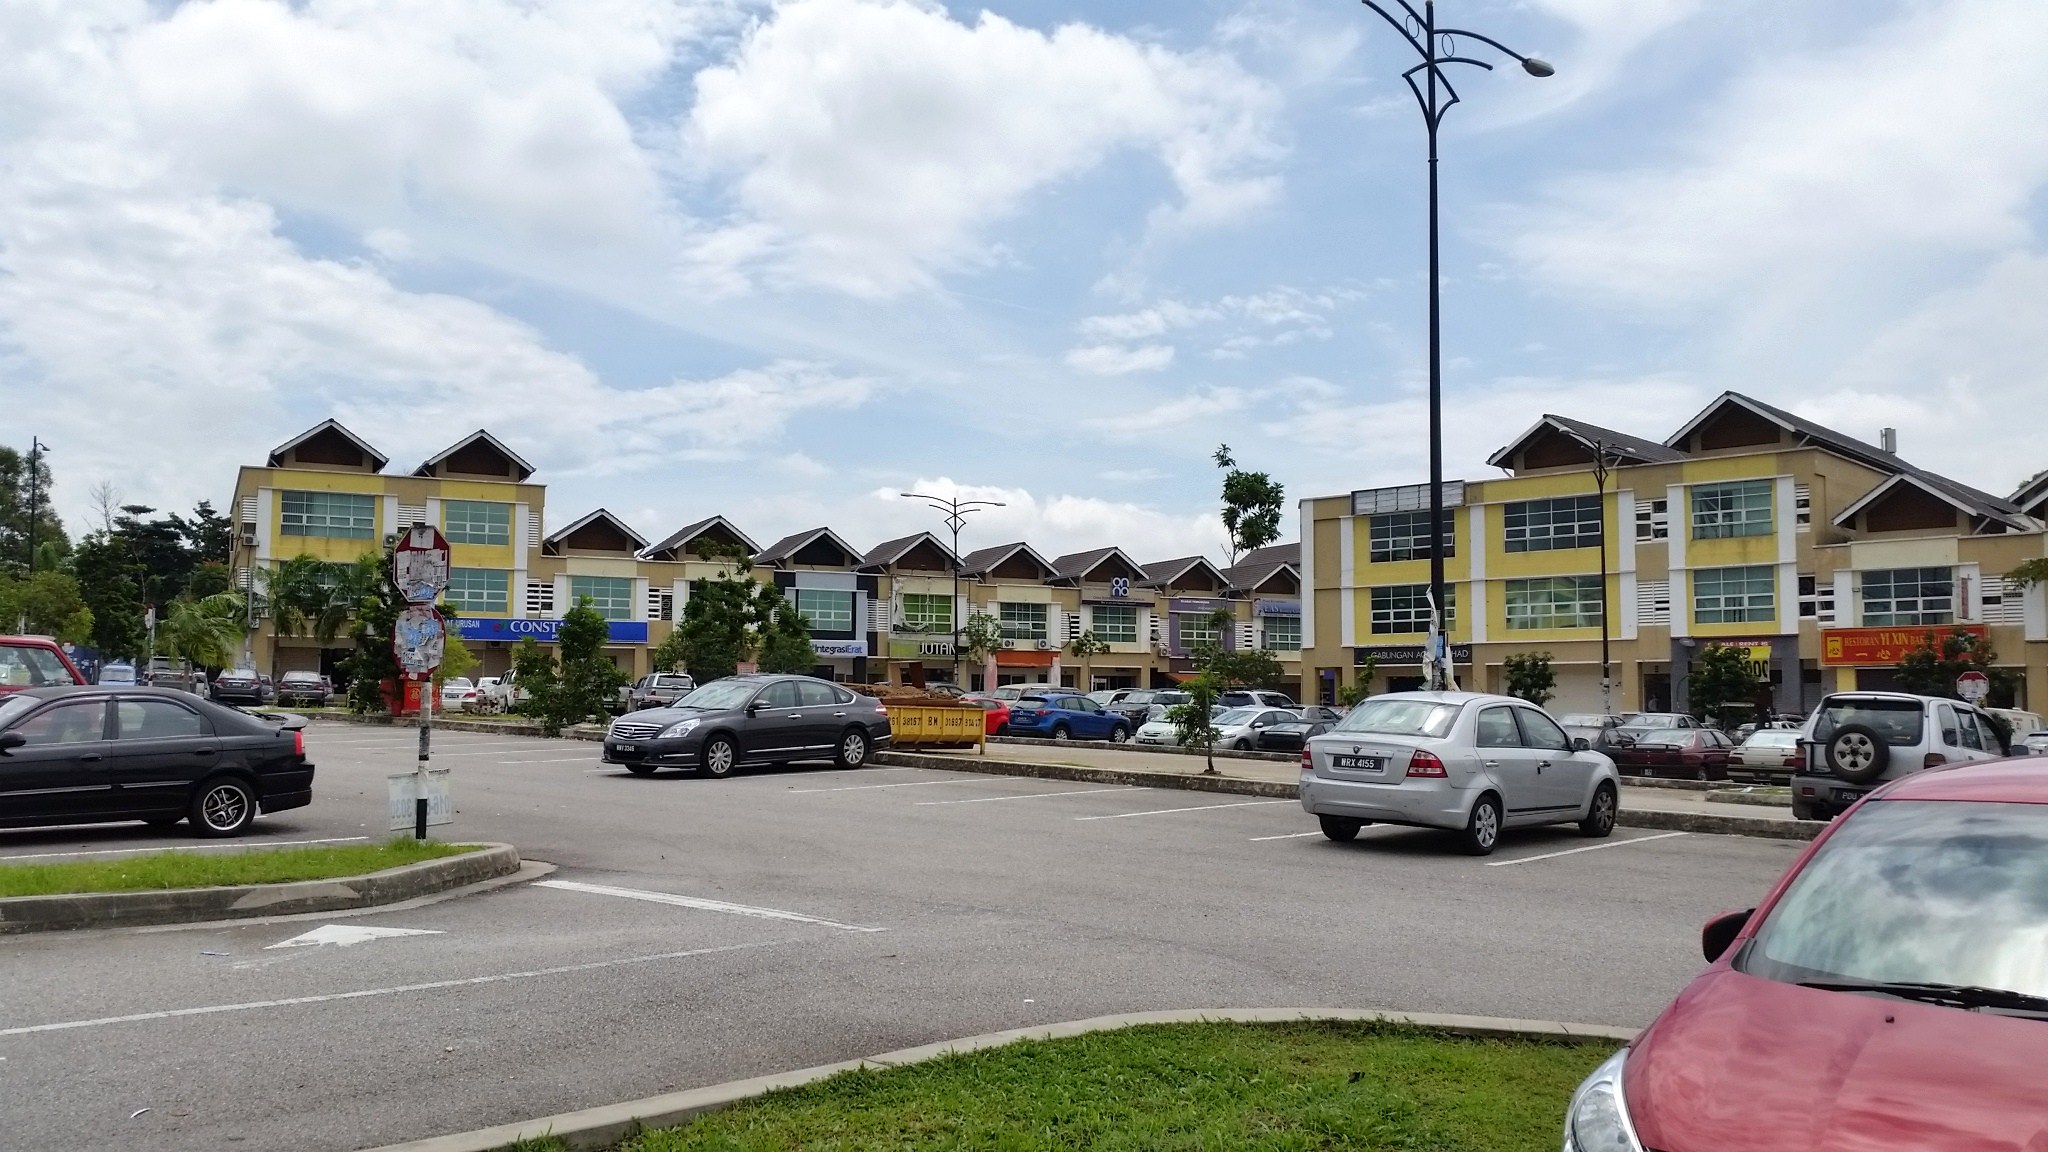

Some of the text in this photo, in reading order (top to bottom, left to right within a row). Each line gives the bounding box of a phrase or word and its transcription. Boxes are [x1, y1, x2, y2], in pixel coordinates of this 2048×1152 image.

[1844, 635, 1879, 647] RESTORAN
[1891, 632, 1909, 645] XIN
[1371, 651, 1413, 660] GABUNGAN
[1341, 757, 1375, 769] WRX 4155
